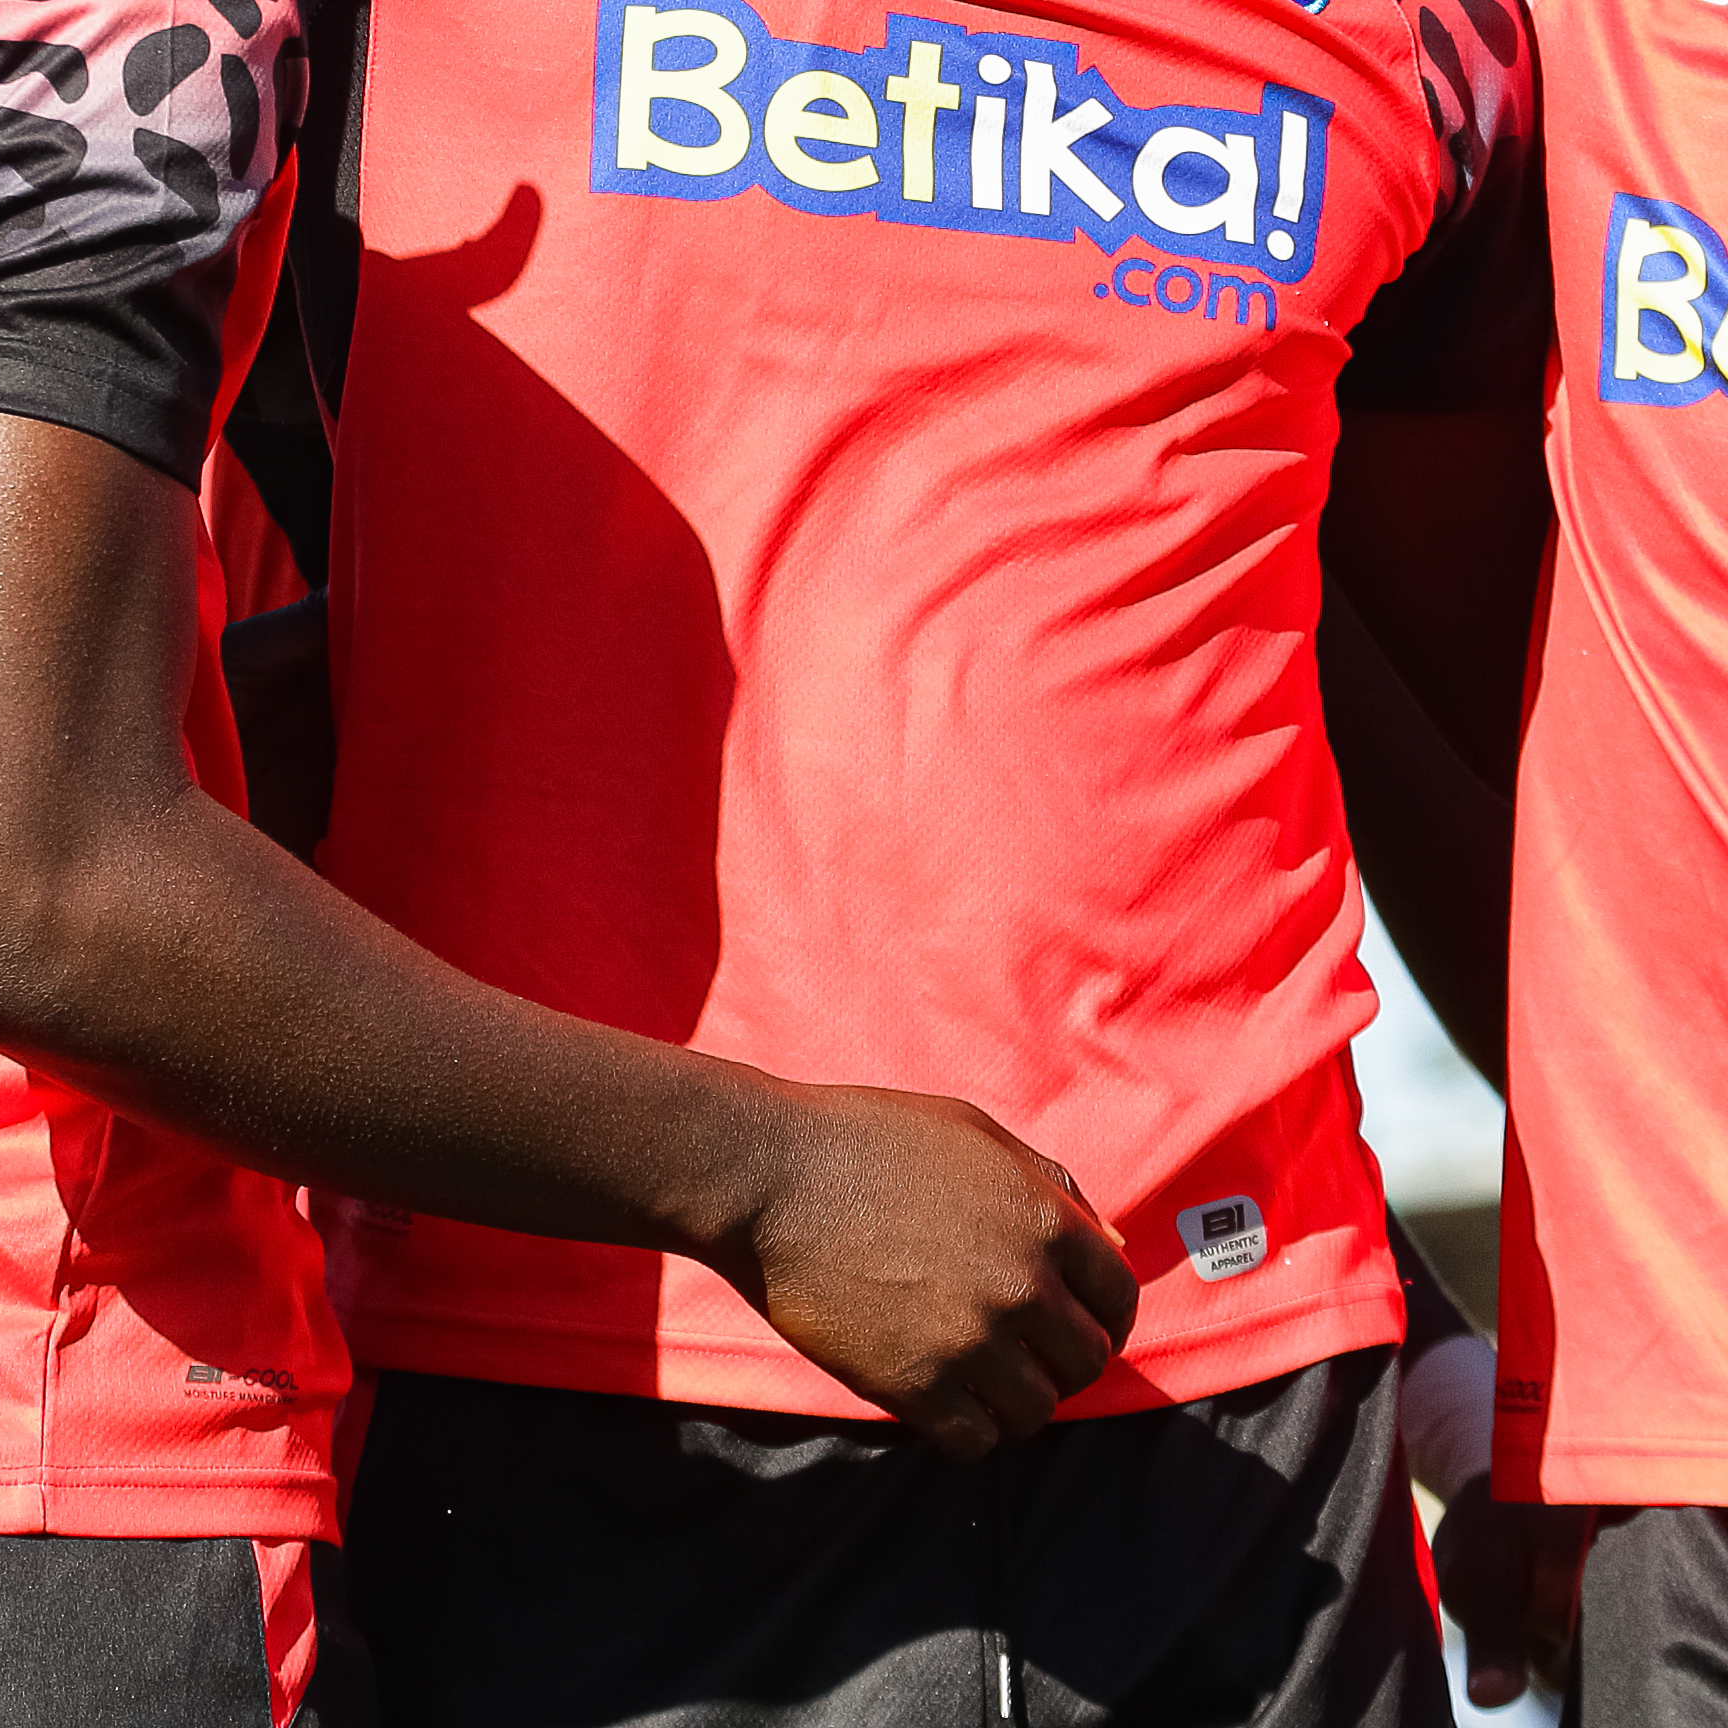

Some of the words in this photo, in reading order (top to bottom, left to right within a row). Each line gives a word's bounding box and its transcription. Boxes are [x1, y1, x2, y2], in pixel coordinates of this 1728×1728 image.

[615, 4, 1308, 261] Betika!
[1093, 257, 1277, 331] .com
[1199, 1234, 1260, 1260] AUTHENTIC
[1210, 1252, 1255, 1273] APPAREL
